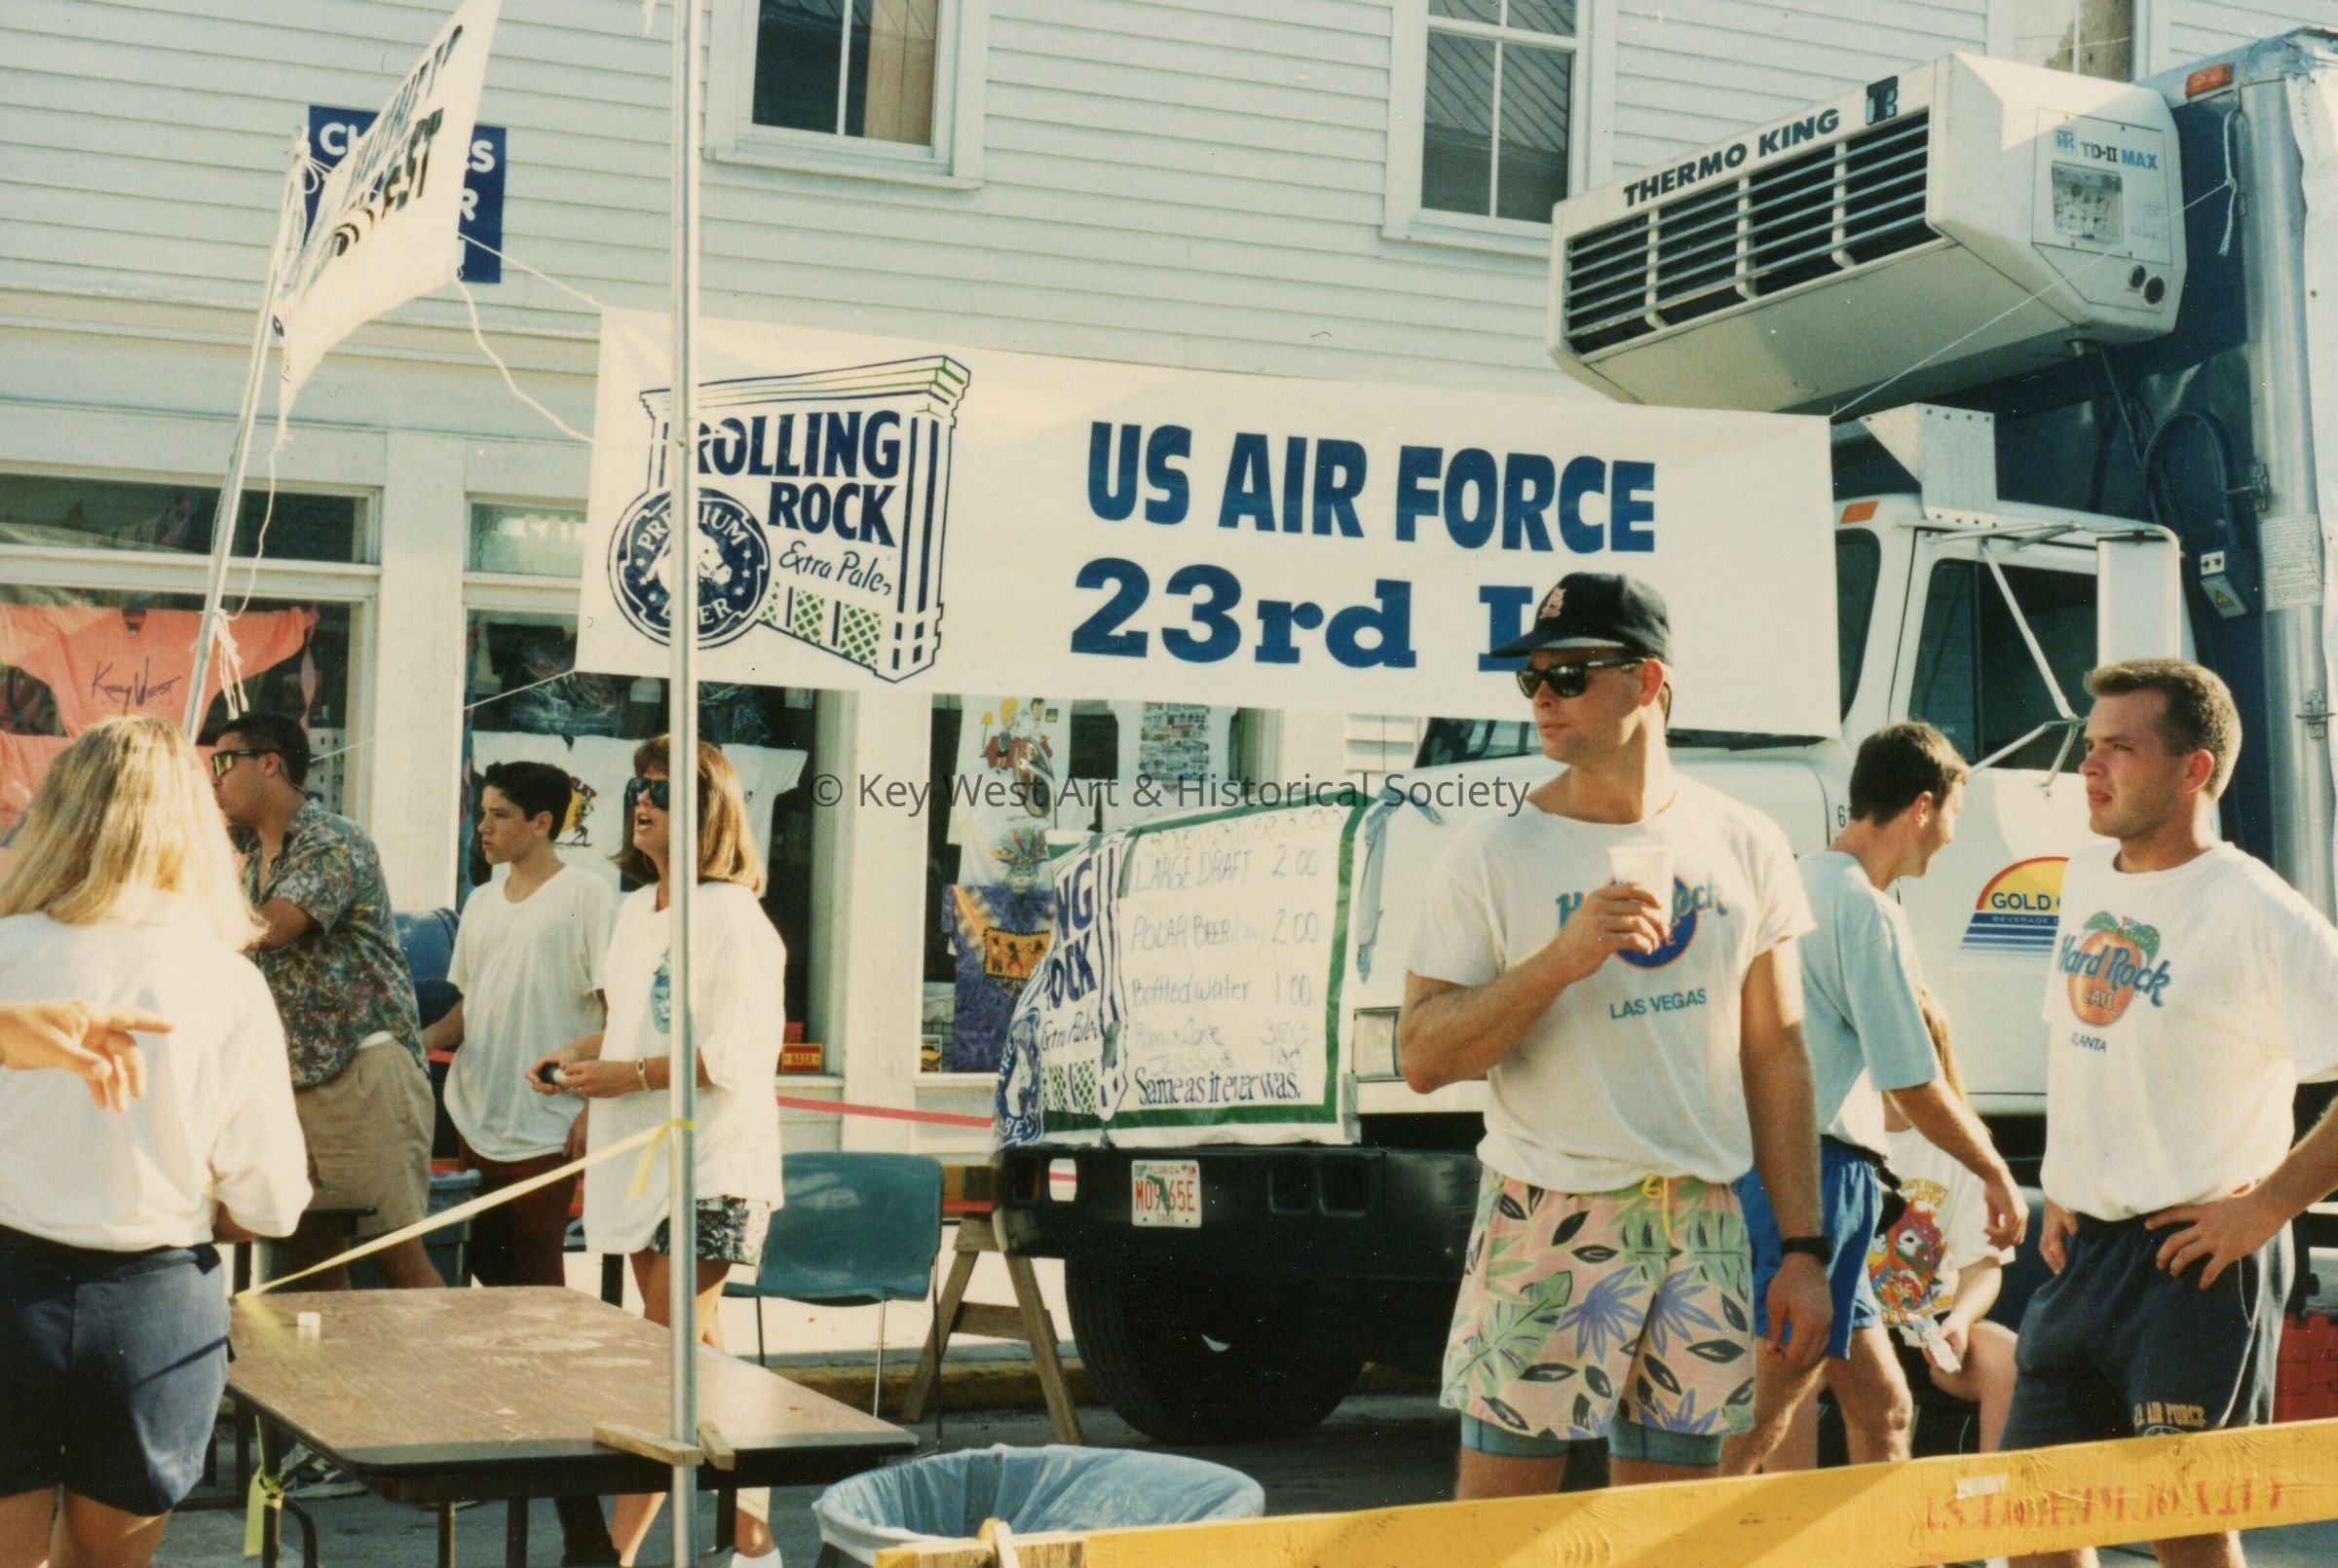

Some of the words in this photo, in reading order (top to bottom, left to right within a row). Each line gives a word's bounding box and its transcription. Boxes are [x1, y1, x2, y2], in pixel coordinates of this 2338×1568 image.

[1623, 142, 1748, 207] THERMO
[1758, 108, 1840, 158] KING
[2081, 141, 2118, 163] TD-II
[2122, 148, 2159, 170] MAX
[1087, 421, 1191, 525] US
[1218, 431, 1367, 539] AIR
[1396, 445, 1655, 553] FORCE
[636, 504, 749, 552] PRIUM
[767, 481, 896, 547] ROCK
[779, 540, 833, 579] Extra
[660, 597, 735, 626] BER
[1071, 557, 1416, 668] 23rd
[1478, 585, 1533, 672] I
[1134, 856, 1190, 893] LARGE
[1198, 849, 1254, 887] DRAFT
[1671, 874, 1729, 917] ock
[1991, 891, 2051, 911] GOLD
[1130, 915, 1187, 953] POLAR
[1193, 914, 1230, 948] BEER
[1991, 915, 2049, 925] BEVERAGE
[1047, 929, 1098, 1010] OCK
[2057, 933, 2108, 980] Hard
[2104, 945, 2171, 1007] Rock
[1132, 974, 1192, 1007] Bottled
[1608, 999, 1646, 1020] LAS
[1649, 987, 1708, 1012] VEGAS
[2081, 987, 2115, 1011] CAFE
[1134, 1066, 1184, 1106] Same
[1184, 1076, 1205, 1103] as
[1208, 1070, 1221, 1103] it
[1223, 1073, 1260, 1102] ever
[1260, 1071, 1301, 1100] was.
[1149, 1164, 1180, 1176] FLORIDA
